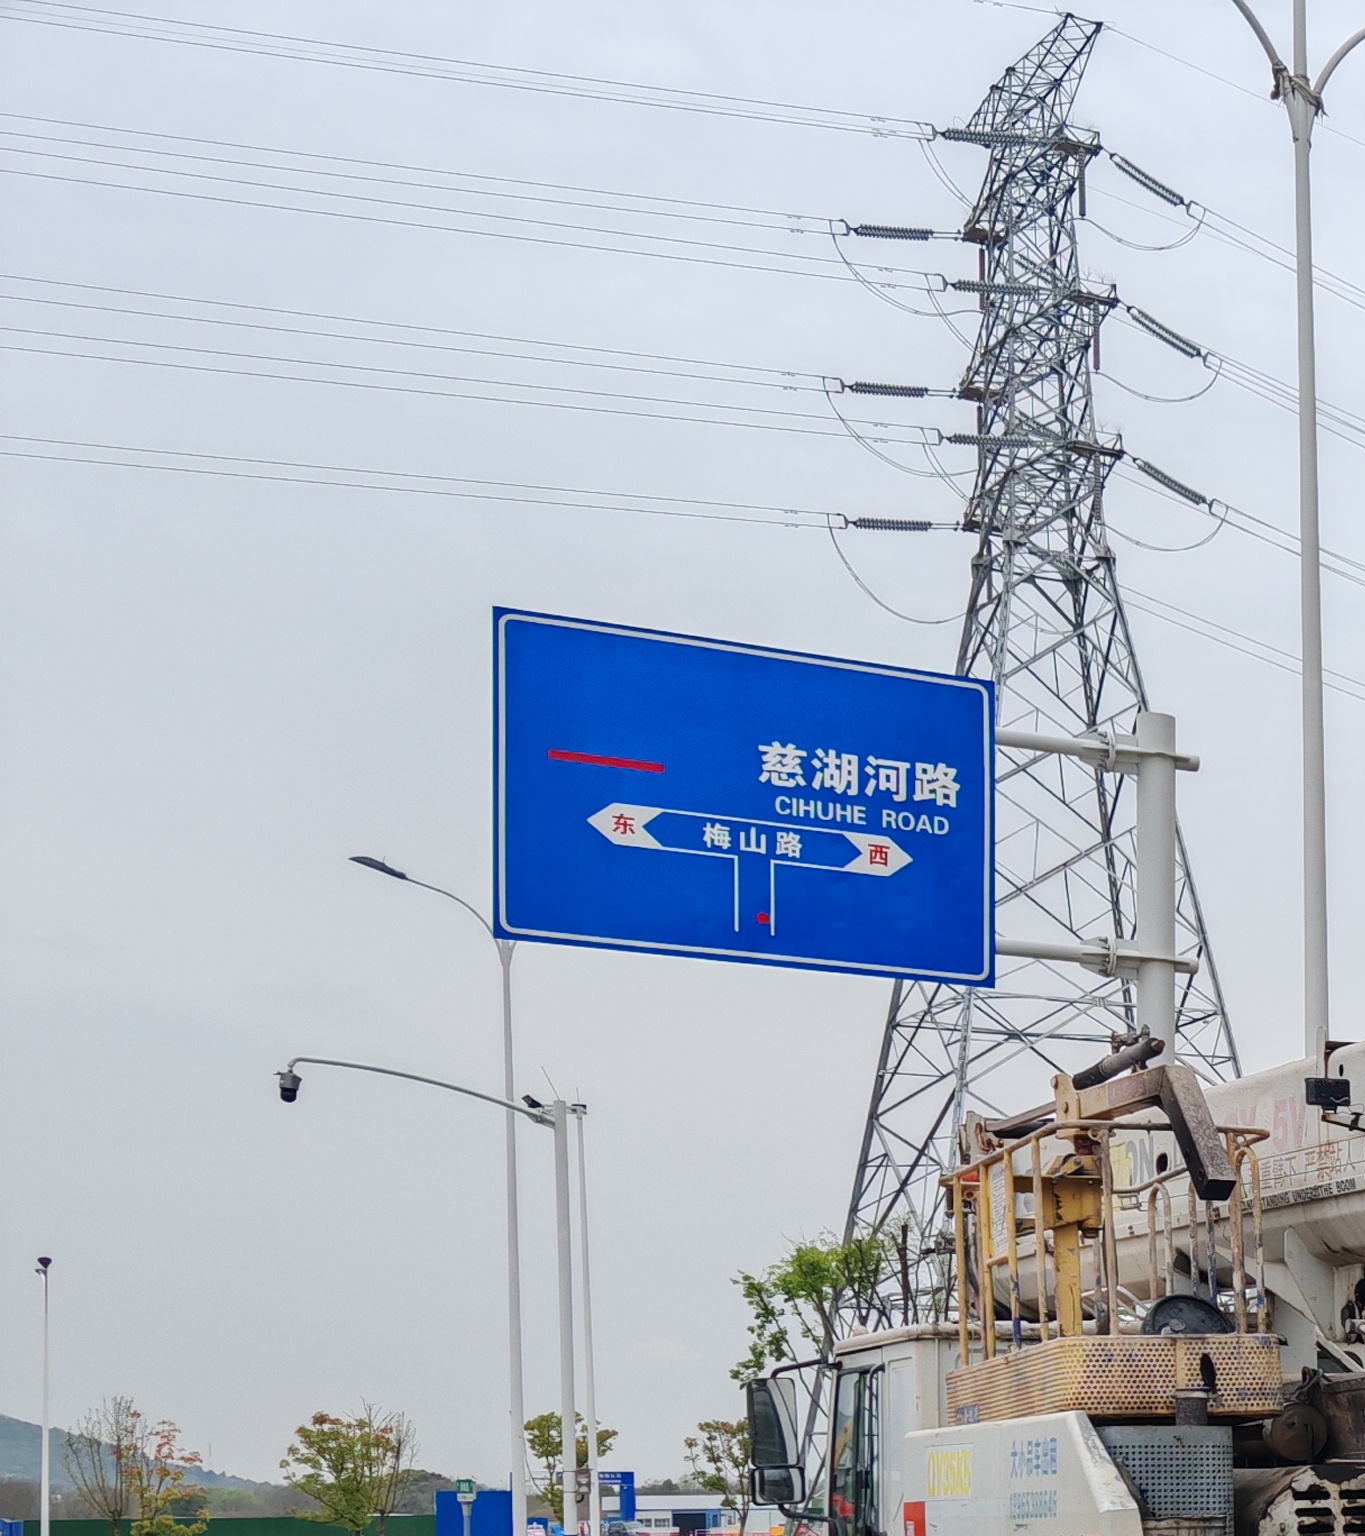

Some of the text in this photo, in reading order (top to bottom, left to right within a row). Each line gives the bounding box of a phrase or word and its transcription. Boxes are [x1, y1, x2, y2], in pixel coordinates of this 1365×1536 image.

[757, 741, 961, 808] 慈湖河路
[611, 812, 636, 836] 东
[774, 796, 950, 836] CIHUHE ROAD
[702, 822, 803, 858] 梅山路
[867, 843, 891, 867] 西
